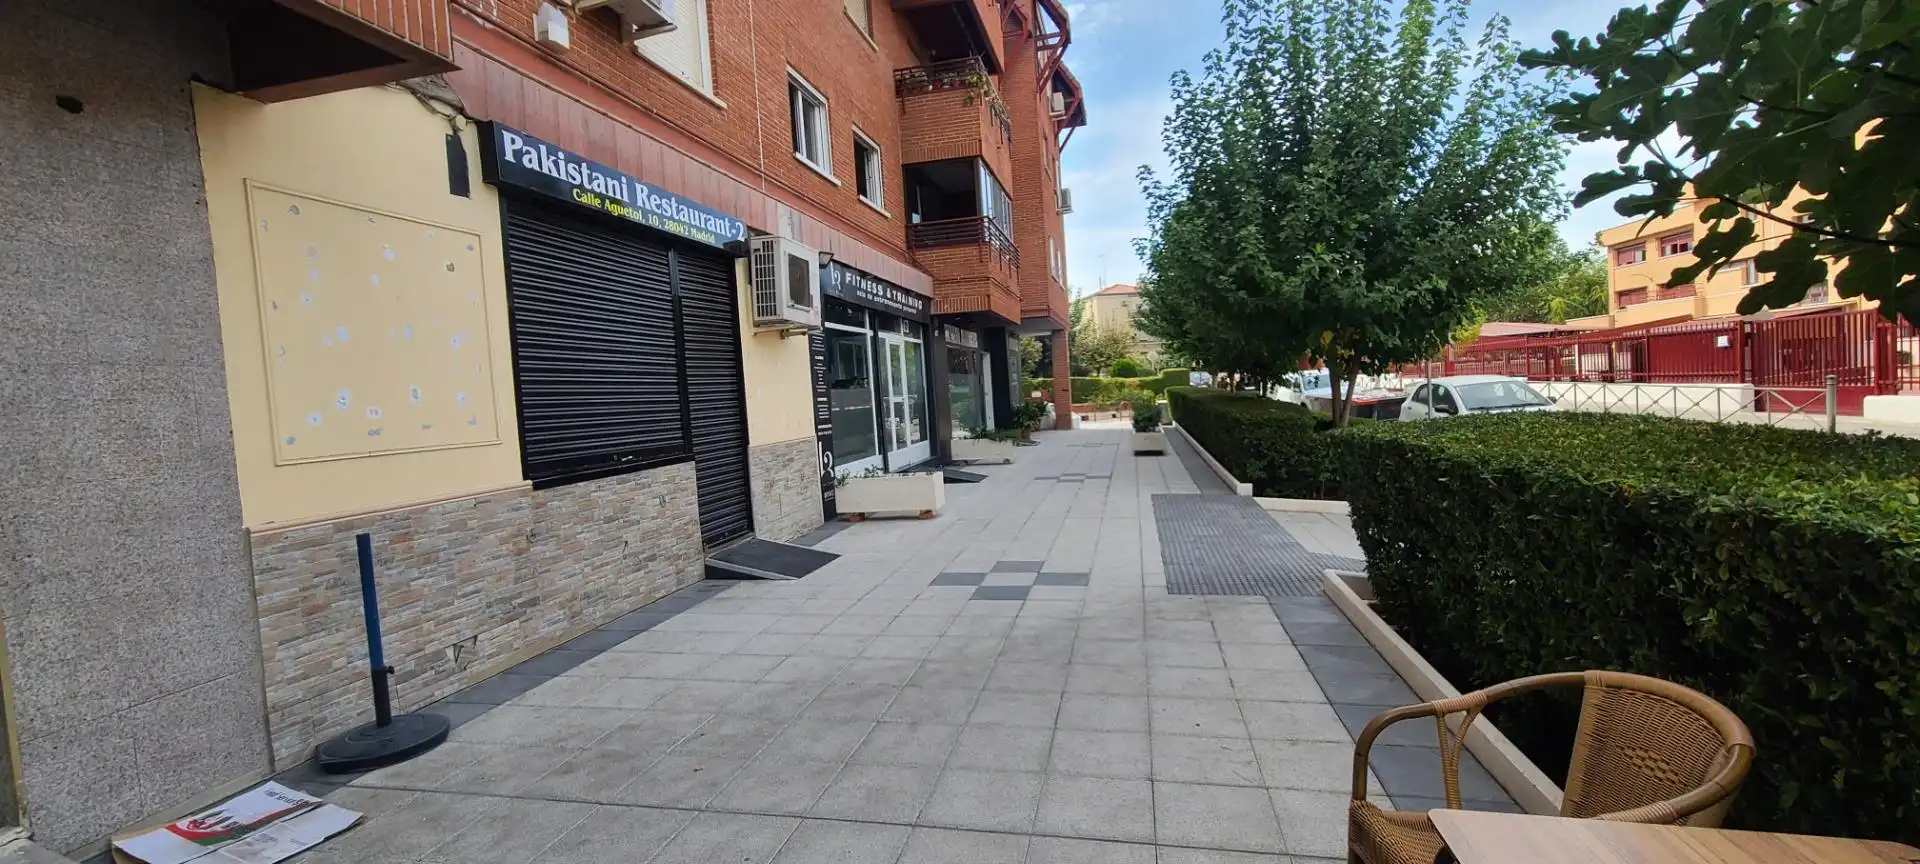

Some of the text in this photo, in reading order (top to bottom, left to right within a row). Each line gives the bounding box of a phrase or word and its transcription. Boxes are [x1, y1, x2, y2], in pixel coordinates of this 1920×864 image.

[502, 129, 745, 242] Pakistani Restaurant-2
[572, 188, 601, 208] Calle
[648, 213, 662, 228] 10,
[664, 218, 689, 236] 28042
[691, 227, 716, 244] Madrid
[845, 272, 883, 296] FITNESS
[886, 287, 891, 299] &
[892, 290, 923, 310] TRAINING
